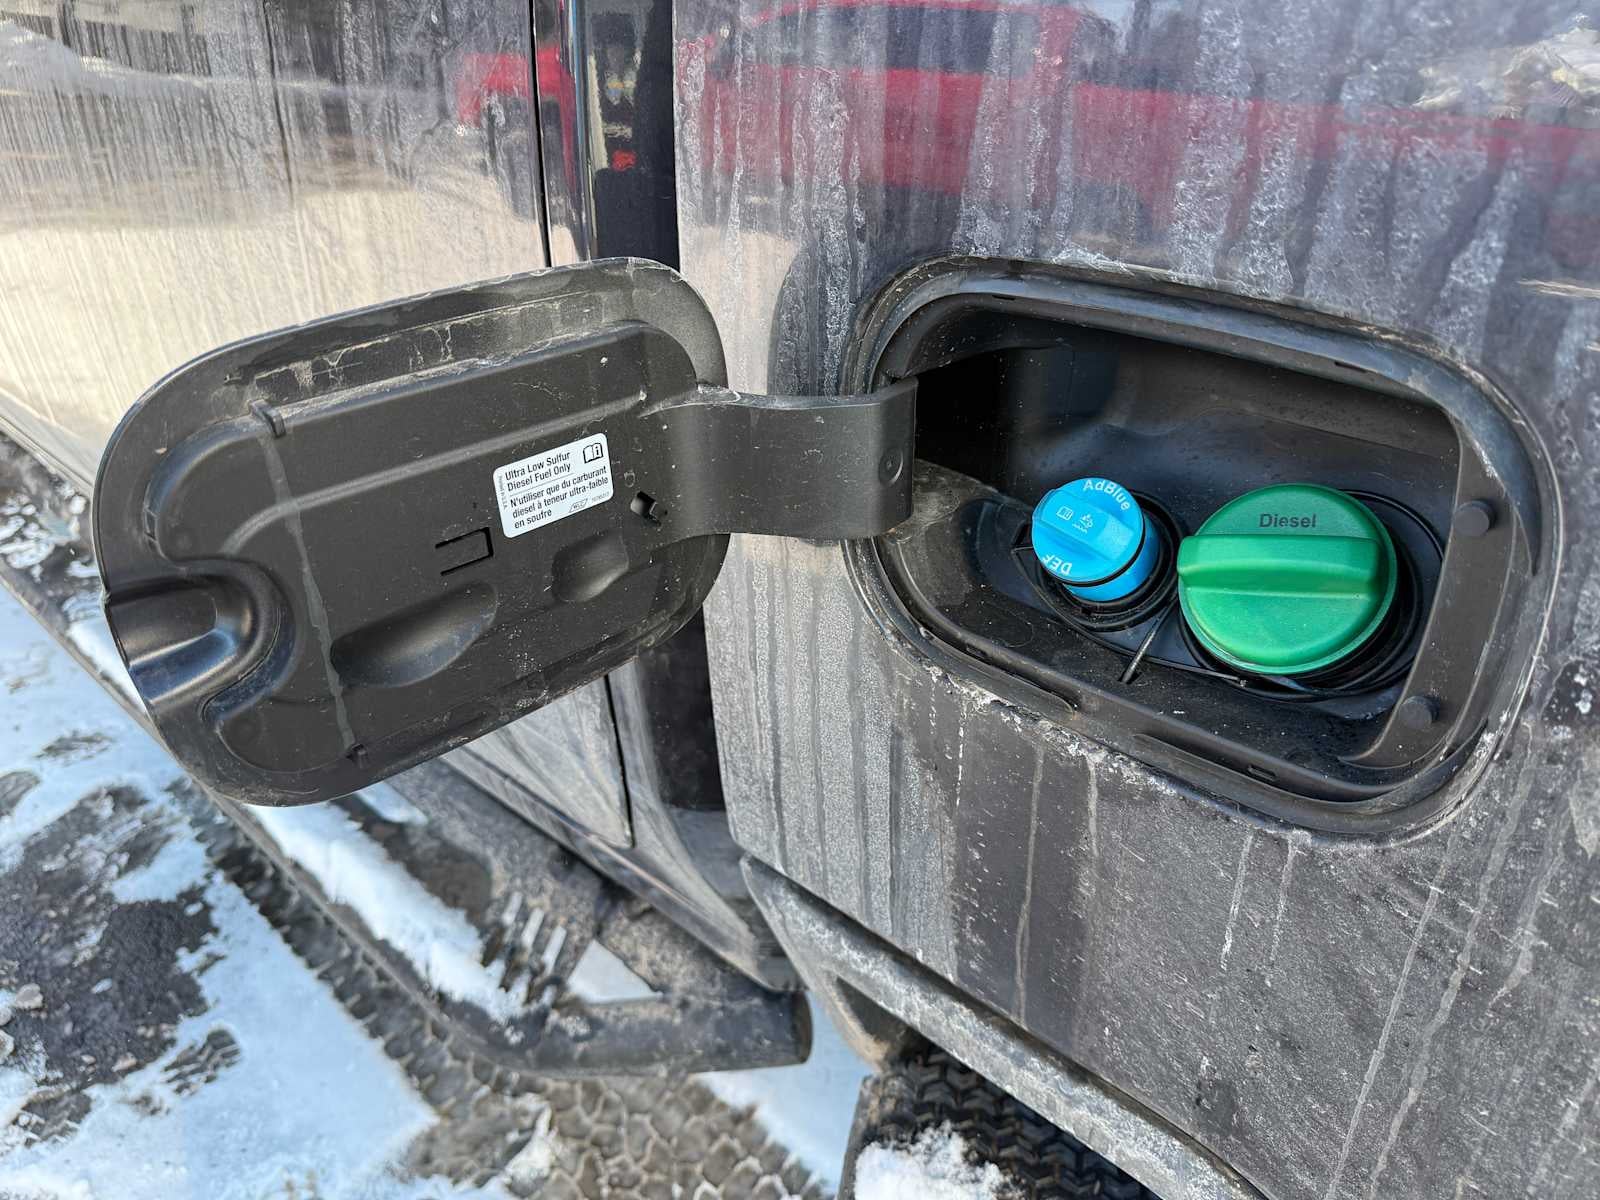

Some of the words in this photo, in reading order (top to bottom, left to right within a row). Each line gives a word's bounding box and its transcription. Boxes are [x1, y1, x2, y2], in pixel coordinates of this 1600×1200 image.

[505, 467, 525, 480] Ultra
[528, 461, 544, 473] Low
[547, 452, 570, 466] Sulfur
[508, 478, 532, 491] Diesel
[535, 470, 551, 482] Fuel
[554, 464, 571, 474] Only
[511, 490, 544, 507] N'utiliser
[546, 485, 559, 495] que
[562, 479, 570, 489] du
[573, 466, 607, 483] carburant
[513, 505, 538, 518] diesel
[544, 494, 567, 506] teneur
[570, 477, 608, 496] ultra-faible
[1083, 480, 1130, 510] AdBlue
[514, 520, 524, 528] en
[527, 509, 552, 524] soufre
[1259, 513, 1316, 527] Diesel
[1042, 554, 1072, 575] DEF
